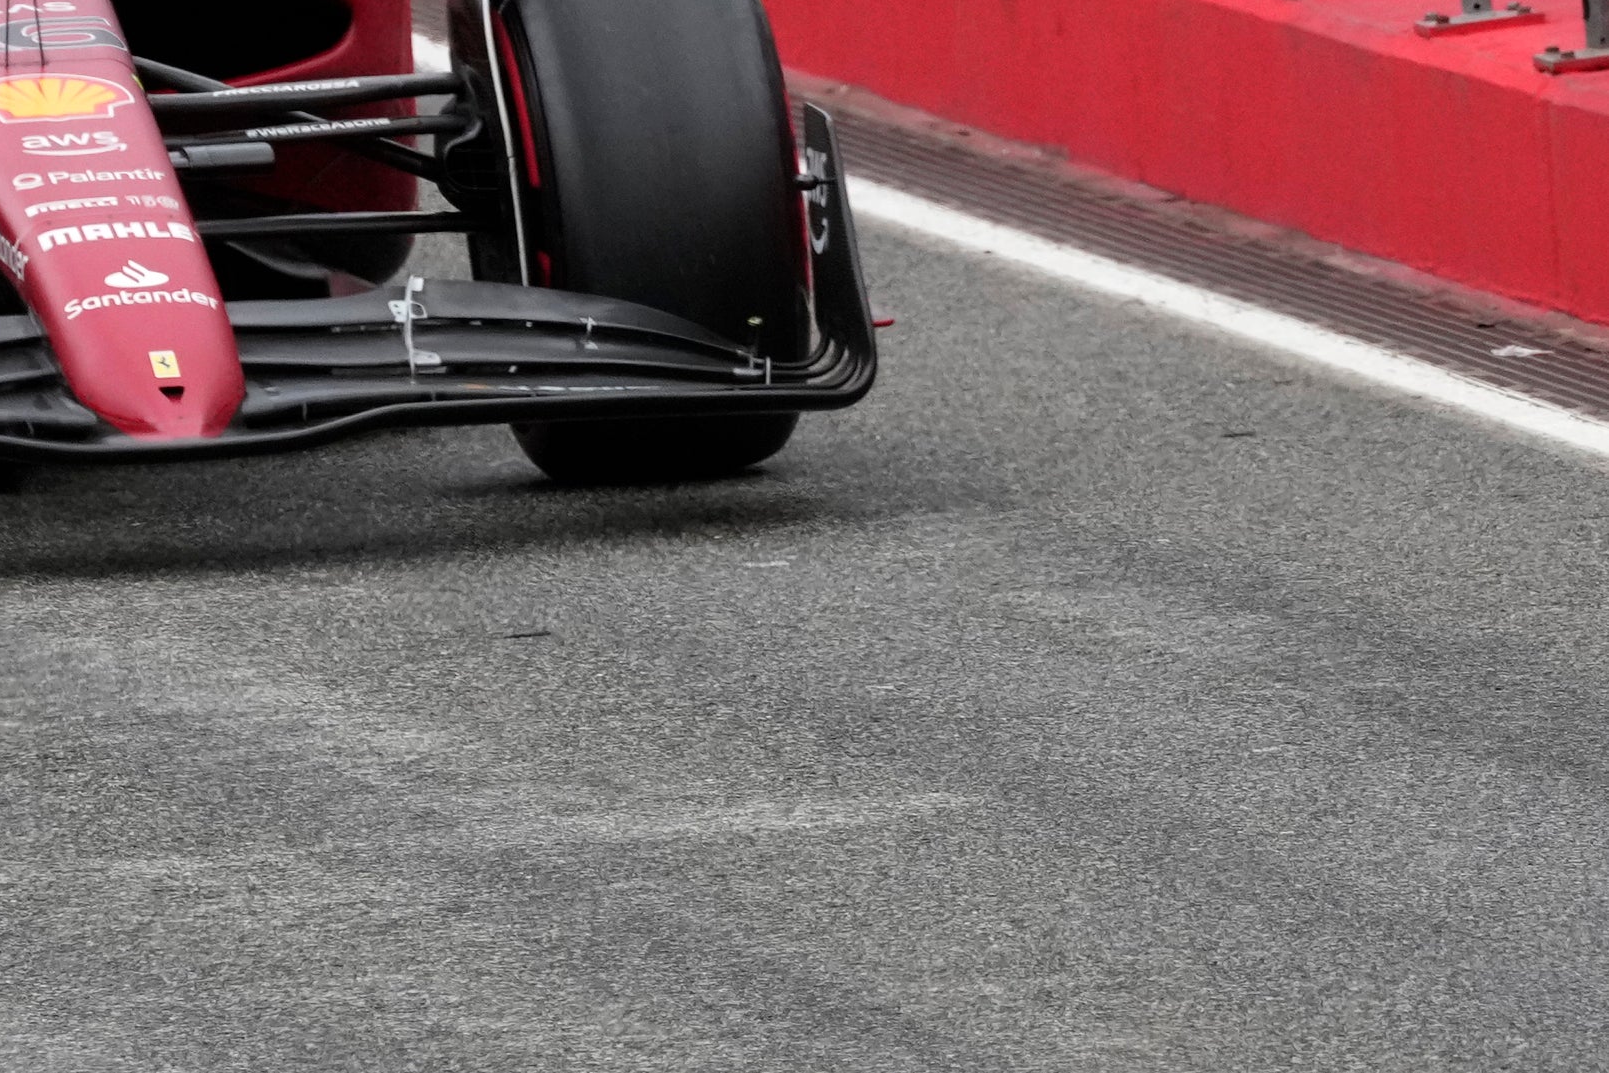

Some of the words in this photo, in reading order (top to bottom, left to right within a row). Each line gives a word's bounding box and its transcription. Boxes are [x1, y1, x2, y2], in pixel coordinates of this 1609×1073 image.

[245, 118, 391, 139] #WeRaceAsOne
[21, 130, 121, 150] aws
[50, 167, 166, 186] Palantir
[24, 196, 119, 218] PIRELLI
[37, 221, 196, 252] MAHLE
[64, 288, 220, 320] Santander
